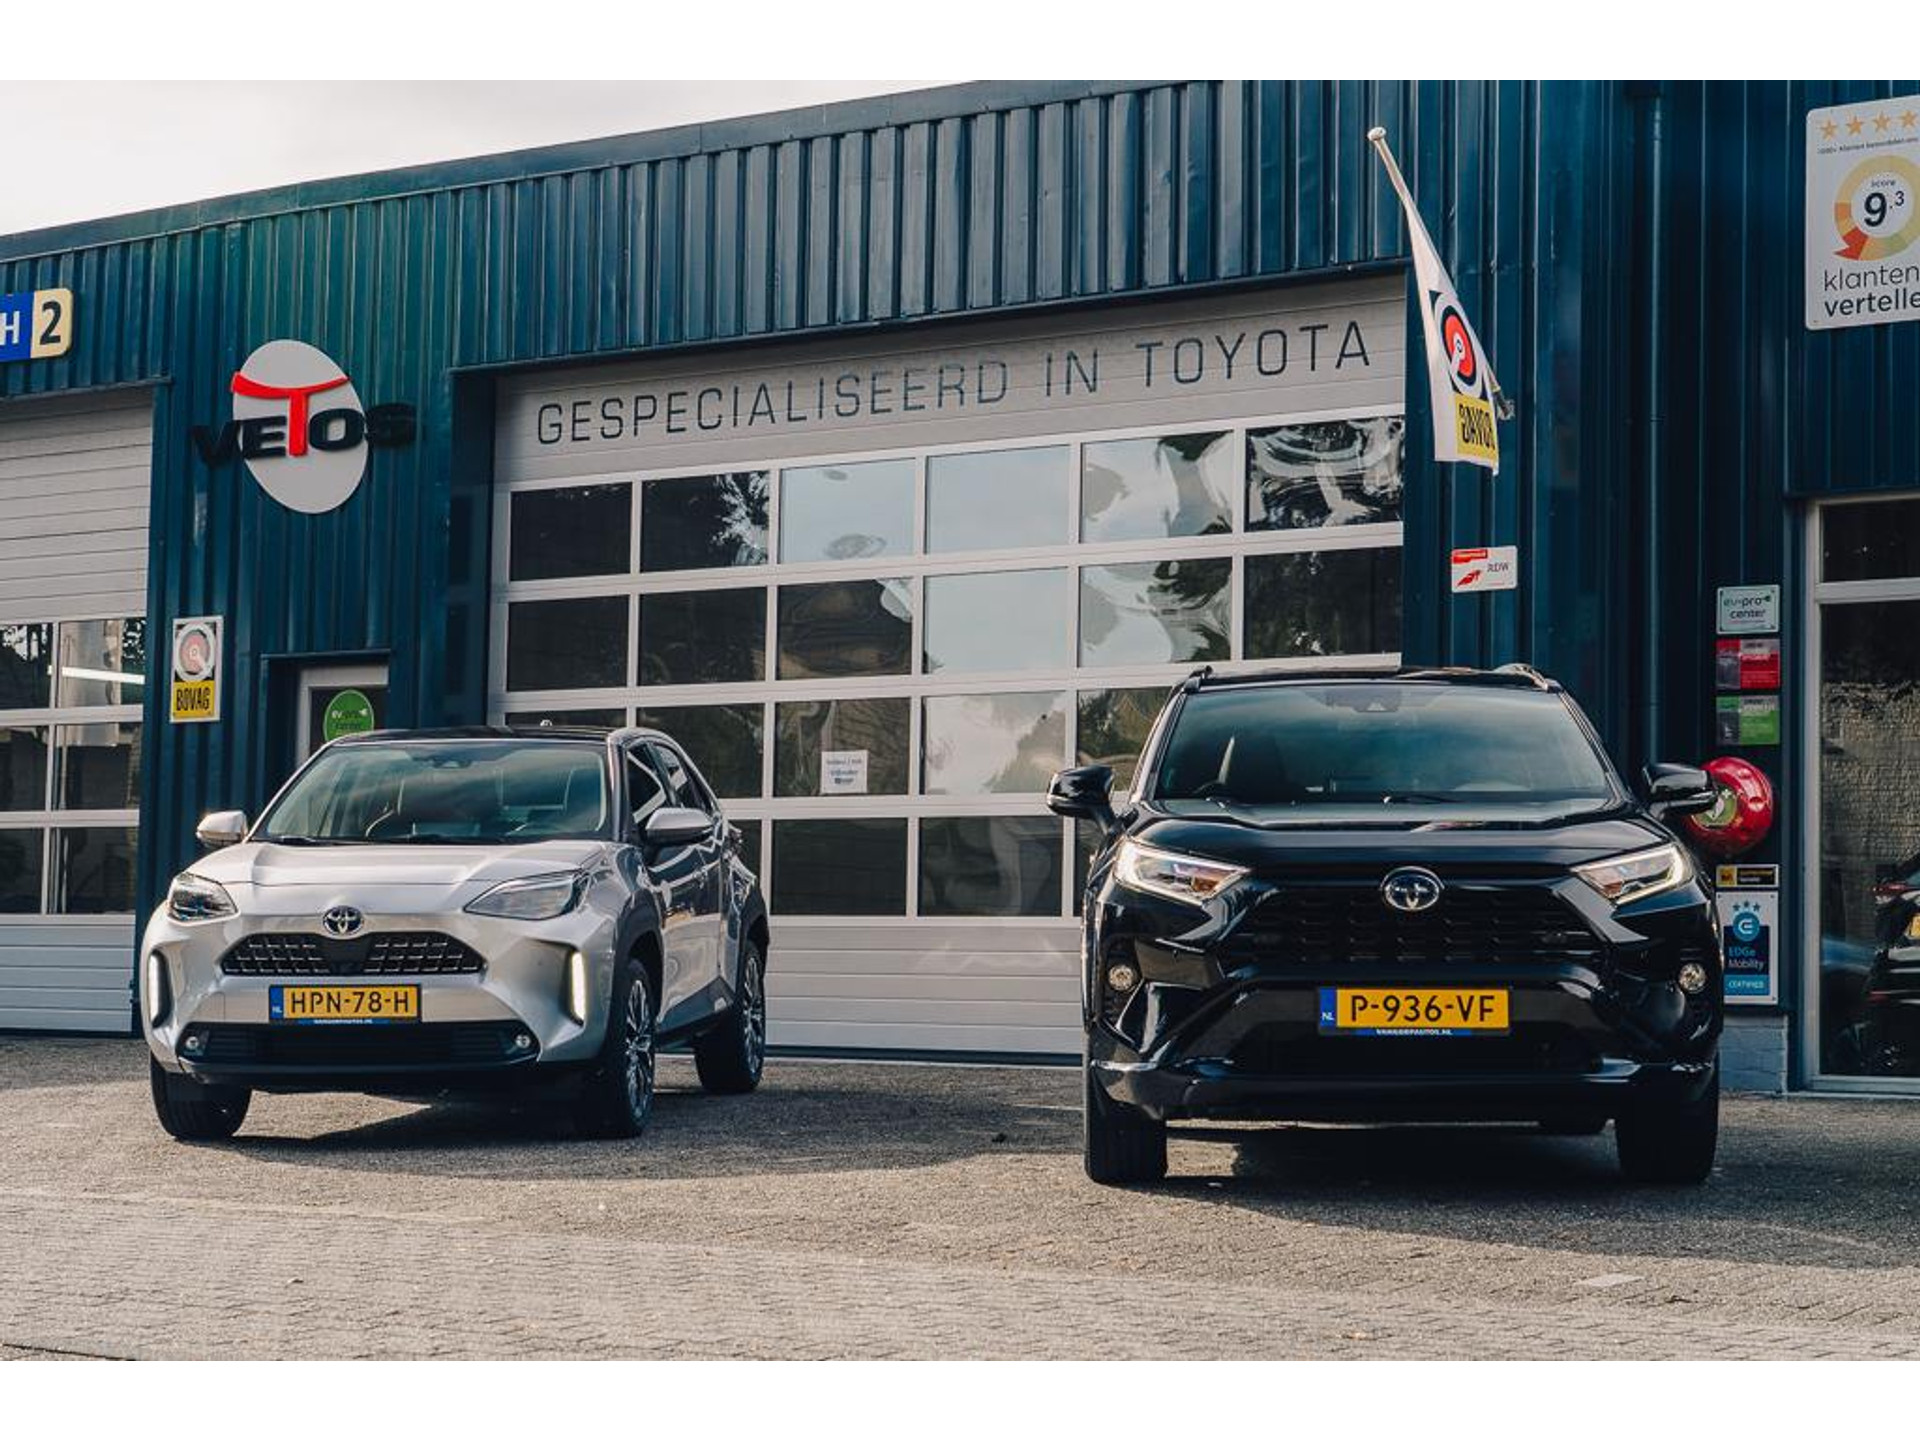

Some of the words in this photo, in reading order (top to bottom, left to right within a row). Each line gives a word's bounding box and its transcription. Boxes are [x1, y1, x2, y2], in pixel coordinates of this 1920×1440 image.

[1824, 265, 1919, 291] klanten
[40, 301, 61, 345] 2
[538, 361, 1008, 445] GESPECIALISEERD
[1046, 347, 1098, 397] IN
[1135, 320, 1370, 388] TOYOTA
[1730, 609, 1765, 619] center
[176, 687, 210, 711] BOVAG
[1729, 958, 1764, 971] Mobility
[291, 990, 409, 1014] HPN-78-H
[1321, 1012, 1334, 1021] NL
[1351, 995, 1495, 1022] P-936-VF
